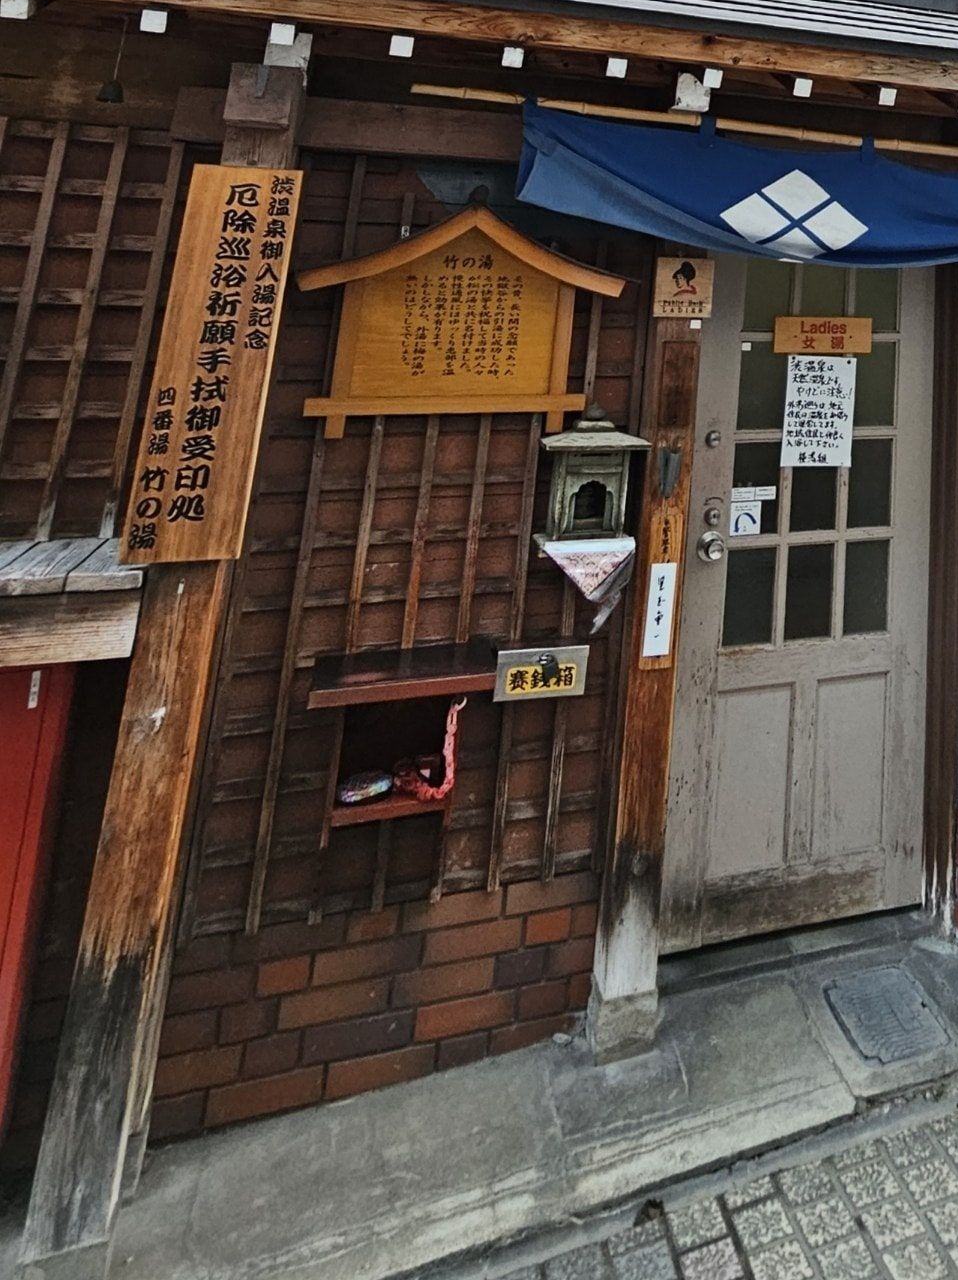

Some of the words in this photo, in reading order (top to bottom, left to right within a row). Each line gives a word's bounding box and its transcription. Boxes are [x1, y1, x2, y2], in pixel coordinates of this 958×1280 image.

[243, 175, 295, 351] 渋温泉御入湯記念
[443, 255, 494, 270] 竹の湯
[167, 183, 261, 523] 厄除巡浴祈願手拭御受印処
[801, 321, 847, 334] Ladies
[147, 388, 176, 457] 四番湯
[128, 465, 170, 550] 竹の湯
